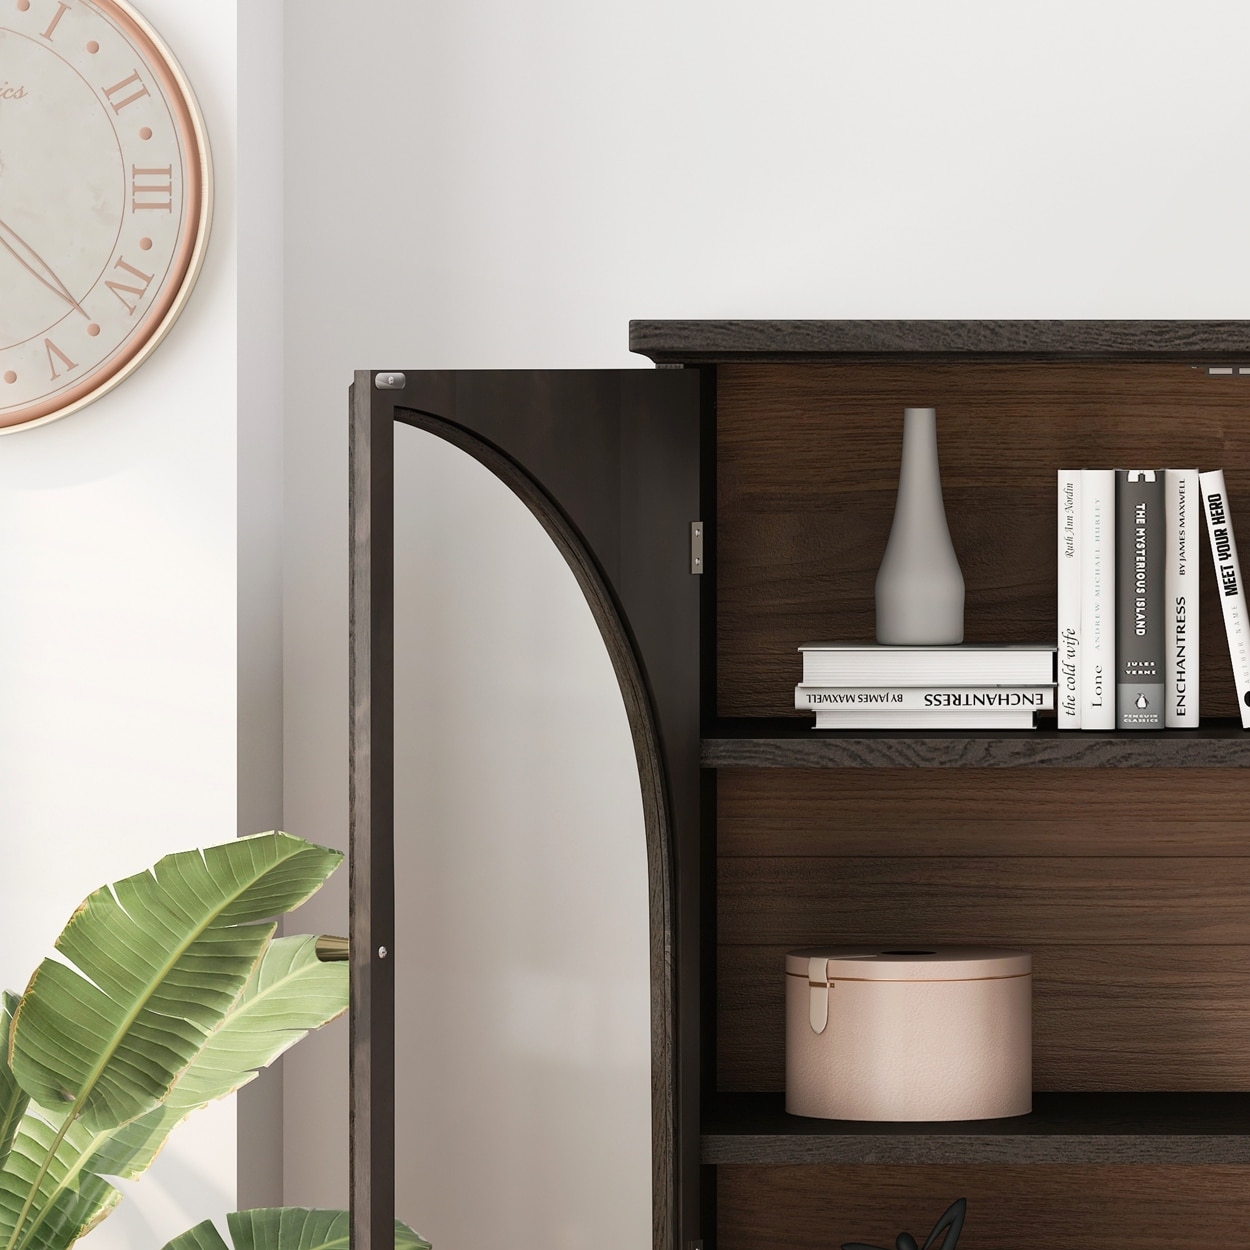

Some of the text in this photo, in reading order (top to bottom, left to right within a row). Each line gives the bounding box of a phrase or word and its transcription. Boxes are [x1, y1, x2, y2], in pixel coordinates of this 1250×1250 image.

[102, 69, 151, 115] II
[132, 163, 172, 214] III
[104, 255, 155, 316] IV
[1063, 482, 1075, 559] Ruth Ann Nordin
[1179, 529, 1187, 562] JAMES
[1207, 493, 1239, 597] MEET YOUR HERO
[1135, 503, 1146, 636] THE MYSTERIOUS ISLAND
[1179, 563, 1186, 576] BY
[1061, 628, 1080, 717] the cold wife
[1176, 597, 1186, 717] ENCHANTRESS
[806, 692, 1044, 707] ENCHANTRESS BY JAMES MAXWELL
